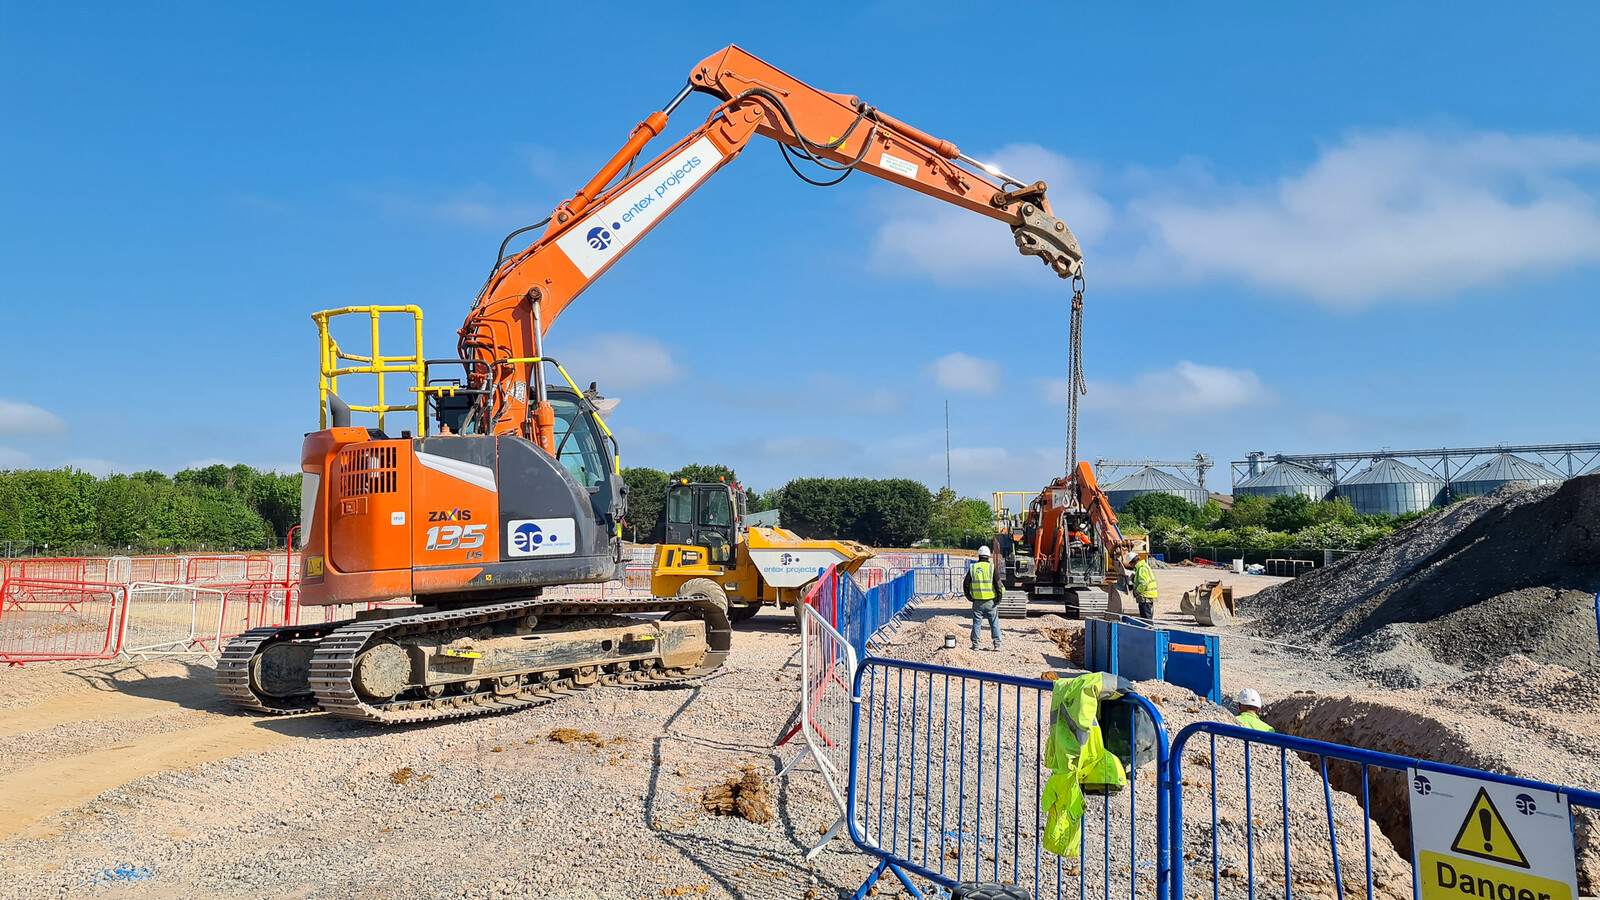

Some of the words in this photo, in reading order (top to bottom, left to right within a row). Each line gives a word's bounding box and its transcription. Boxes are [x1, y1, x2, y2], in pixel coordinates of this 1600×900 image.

[587, 228, 612, 250] ep
[622, 193, 655, 223] entex
[654, 156, 702, 198] projects
[428, 507, 472, 522] ZAXIS
[425, 524, 488, 551] 135
[513, 530, 544, 552] ep
[465, 550, 484, 560] US
[785, 566, 817, 574] projects
[1413, 778, 1432, 796] ep
[1515, 796, 1537, 816] ep
